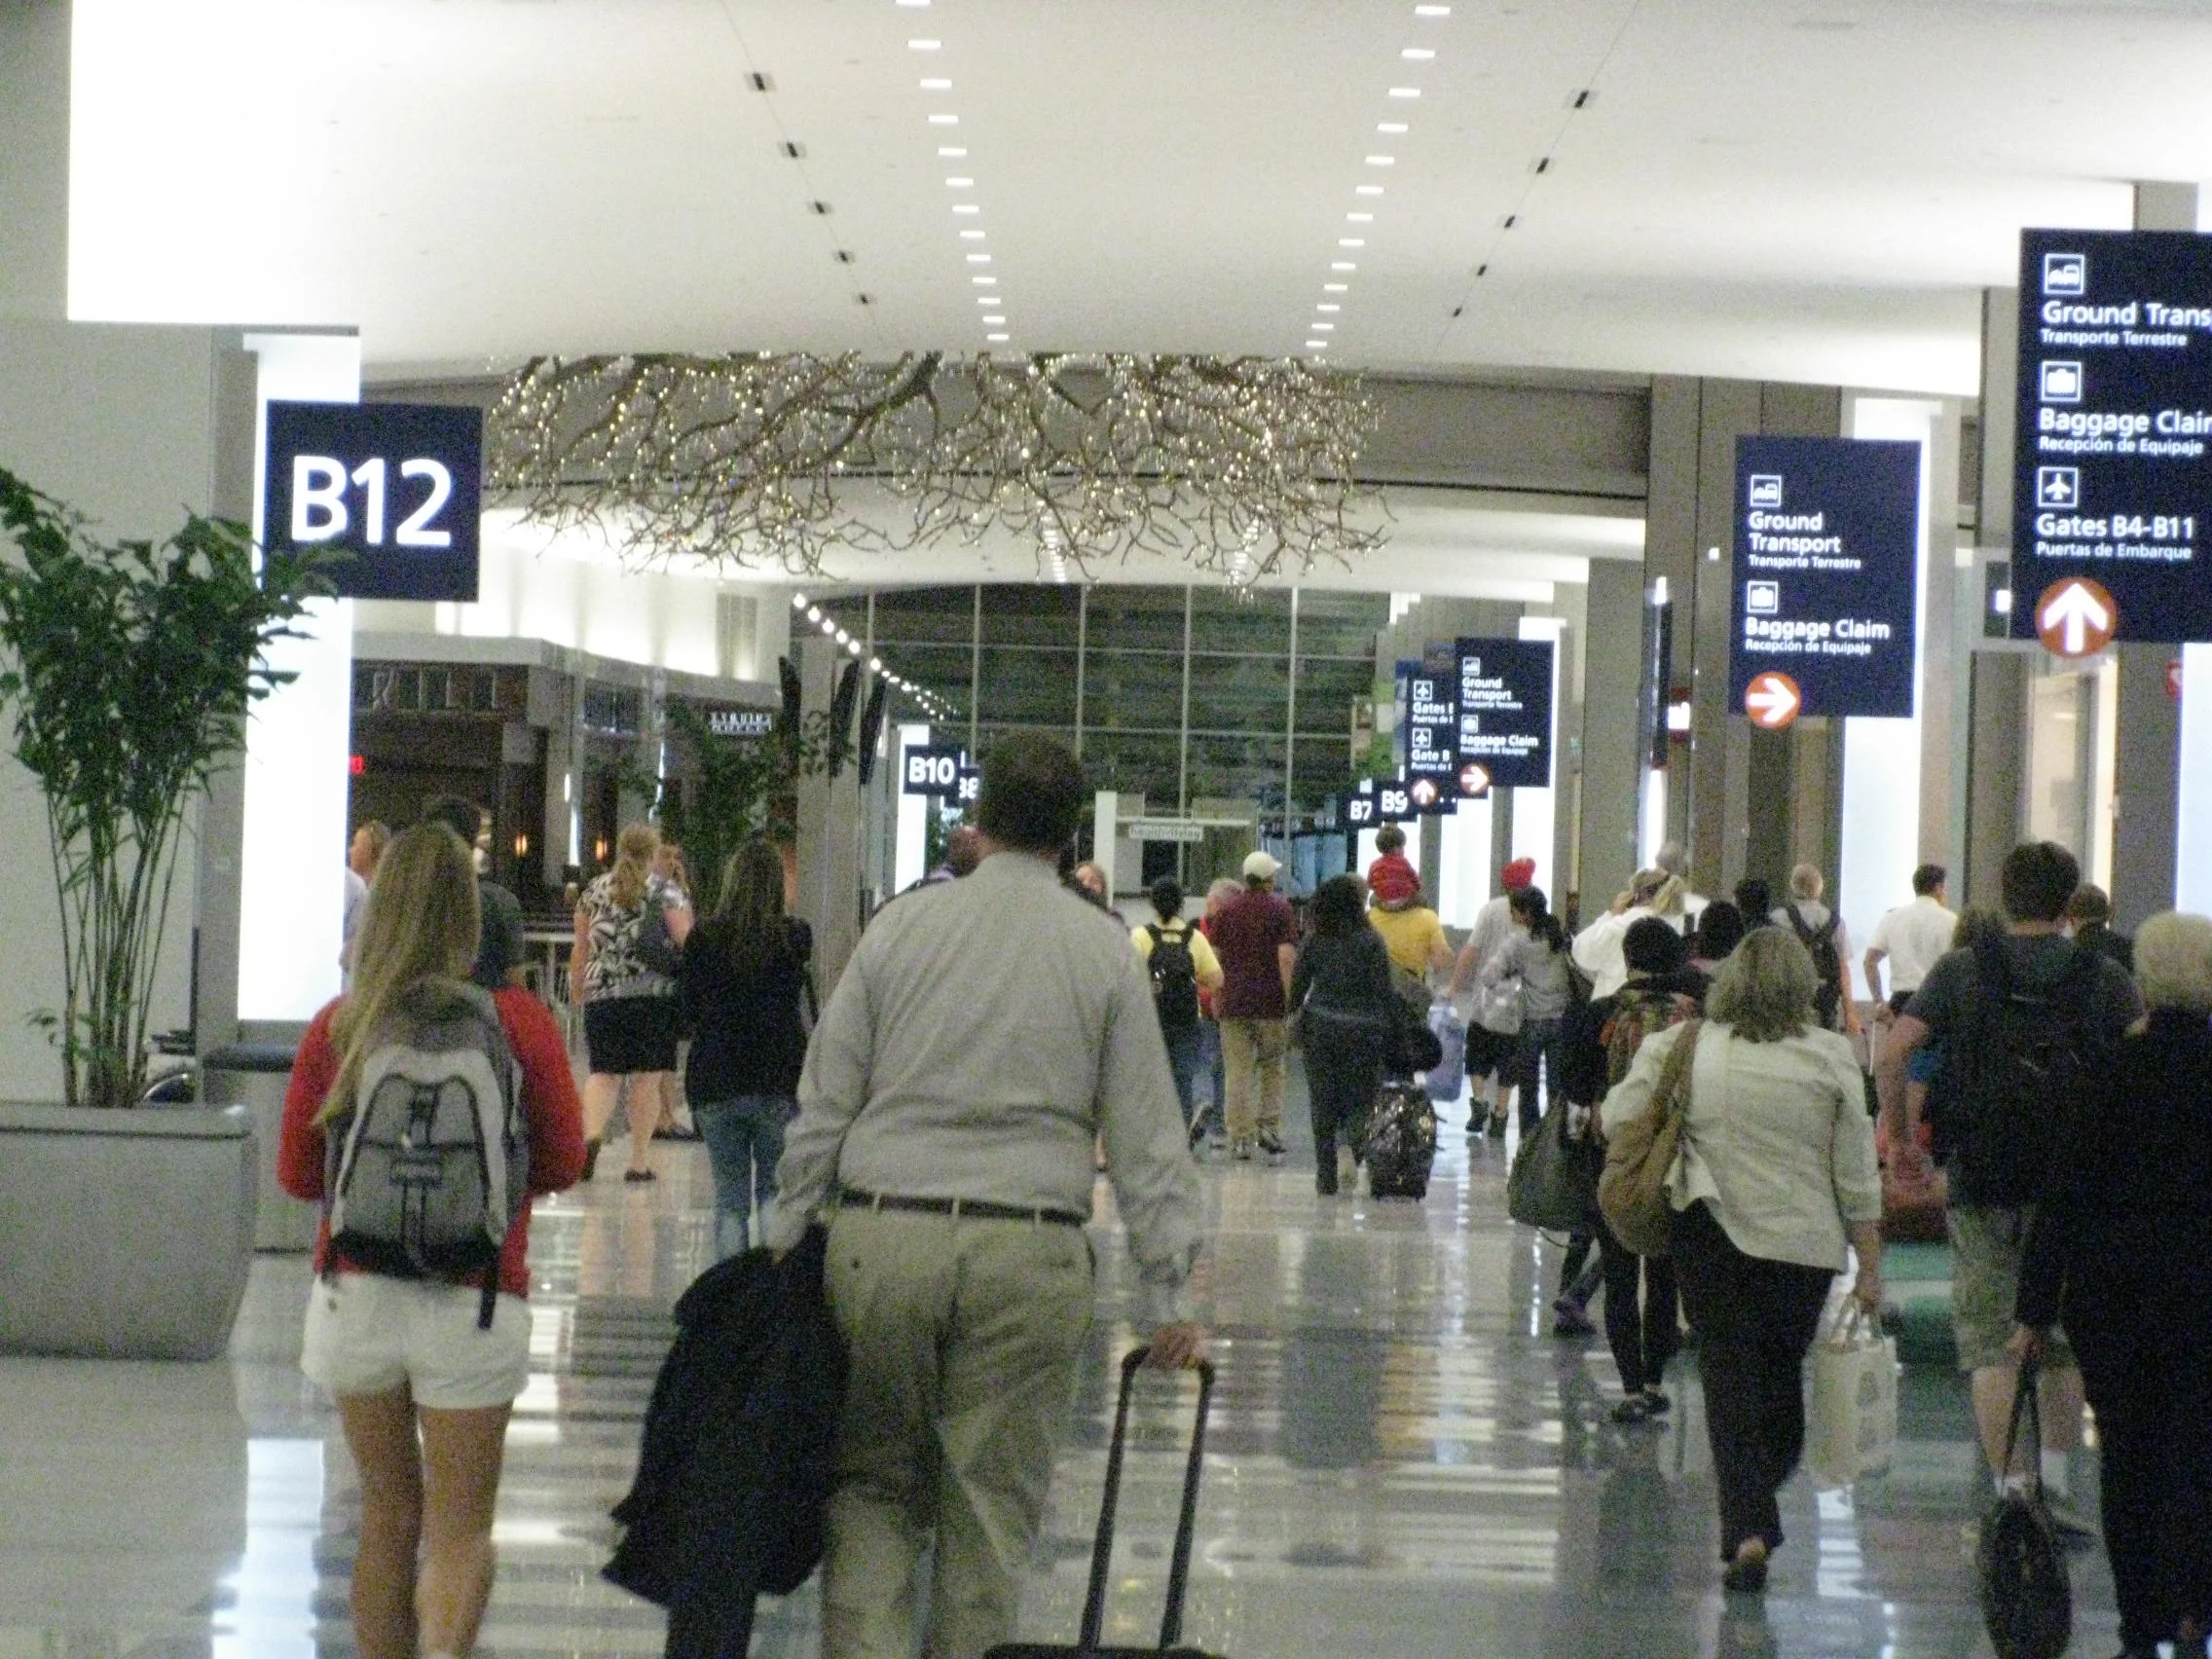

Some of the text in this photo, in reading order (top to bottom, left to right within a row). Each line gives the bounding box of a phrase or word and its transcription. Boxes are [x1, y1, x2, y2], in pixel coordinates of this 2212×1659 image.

[2043, 301, 2212, 332] Ground Trans
[2040, 329, 2189, 347] Transporte Terrestre
[2040, 408, 2150, 437] Baggage
[2039, 436, 2203, 456] Recepción de Equipaje
[291, 455, 451, 546] B12
[1750, 511, 1823, 532] Ground
[2037, 513, 2194, 539] Gates B4-B11
[1750, 533, 1841, 554] Transport
[2036, 541, 2193, 561] Puertas de Embarque
[1749, 554, 1862, 570] Transporte Terrestre
[1746, 616, 1890, 640] Baggage Claim
[1746, 638, 1871, 656] Recepción de Equipaje
[1462, 677, 1502, 689] Ground
[1462, 687, 1511, 701] Transport
[1413, 701, 1445, 715] Gates
[1460, 734, 1538, 748] Baggage Claim
[908, 756, 954, 785] B10
[1350, 800, 1372, 820] B7
[1382, 790, 1408, 813] B9
